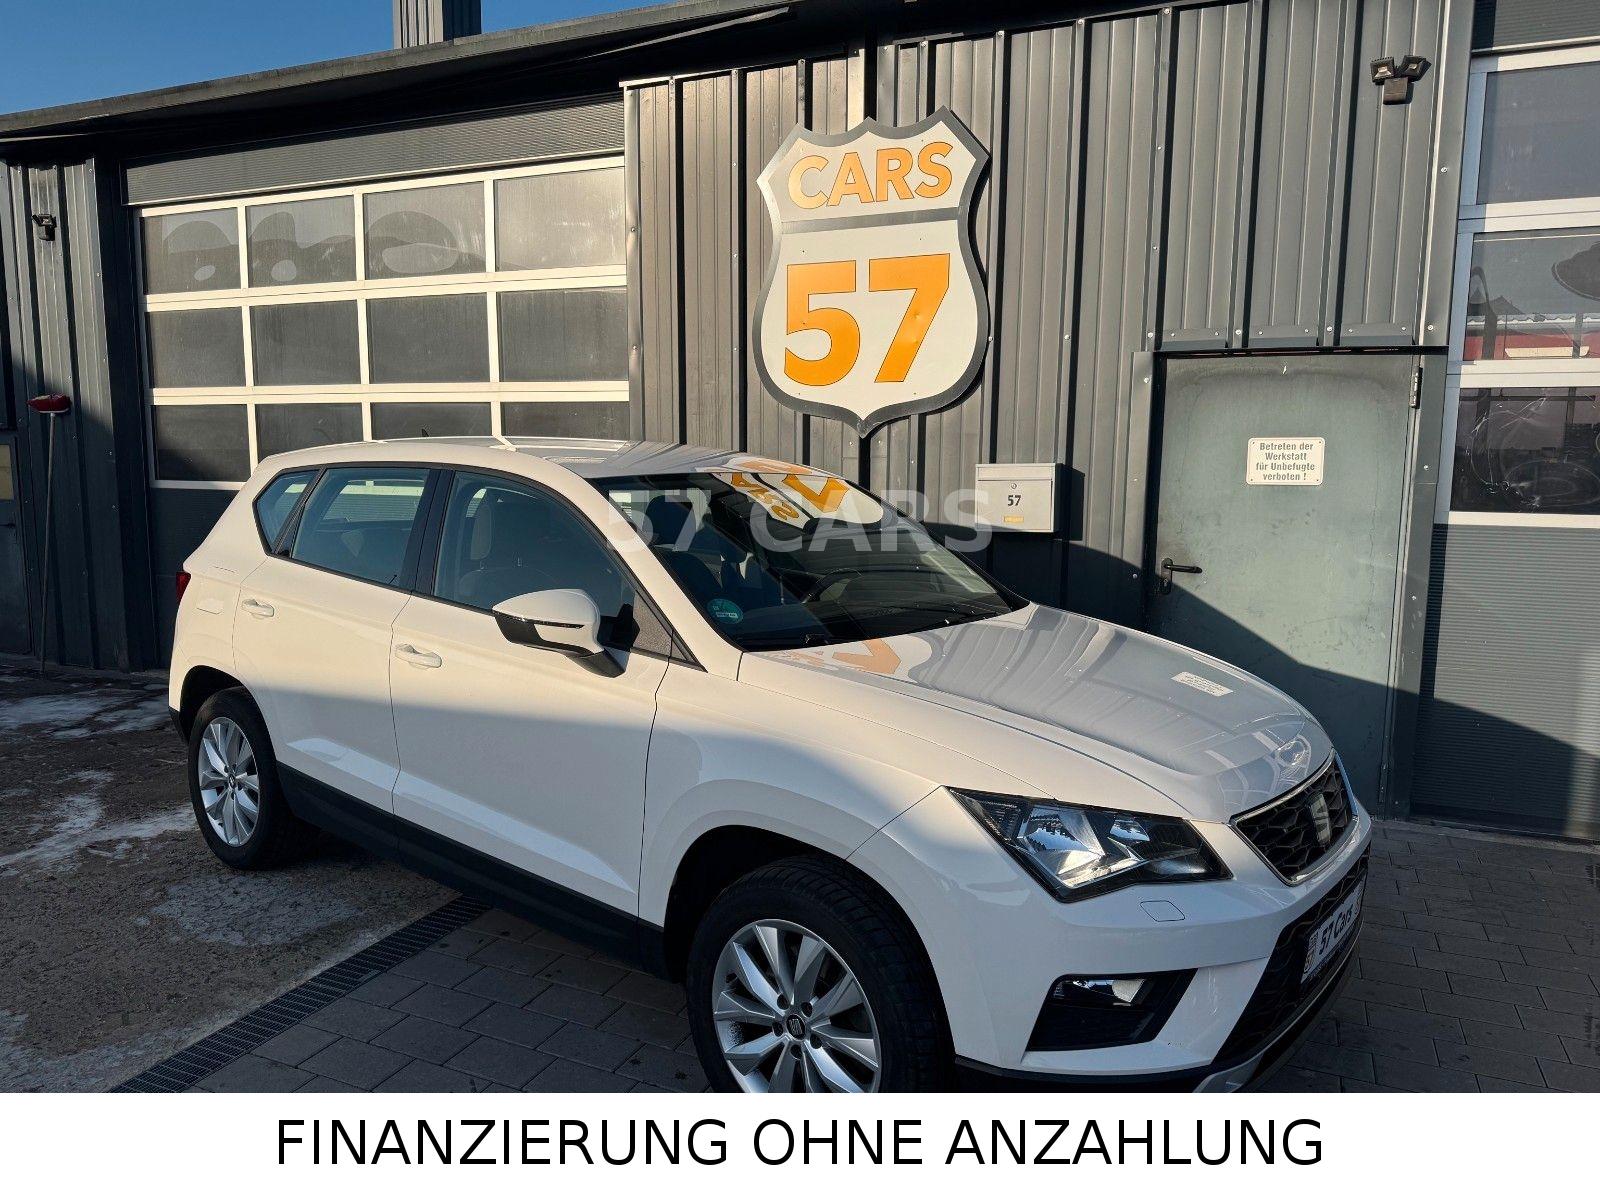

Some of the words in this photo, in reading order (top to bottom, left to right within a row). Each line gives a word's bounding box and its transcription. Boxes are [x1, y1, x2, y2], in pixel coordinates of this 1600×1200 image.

[788, 141, 953, 209] CARS
[784, 253, 951, 387] 57
[1259, 442, 1297, 451] Betreten
[1299, 442, 1314, 451] der
[1265, 452, 1307, 461] Werkstatt
[1255, 462, 1268, 471] für
[1270, 462, 1315, 473] Unbefugte
[1262, 472, 1300, 481] verboten
[1007, 494, 1022, 507] 57
[1318, 920, 1335, 956] 57
[1334, 903, 1354, 939] Cars
